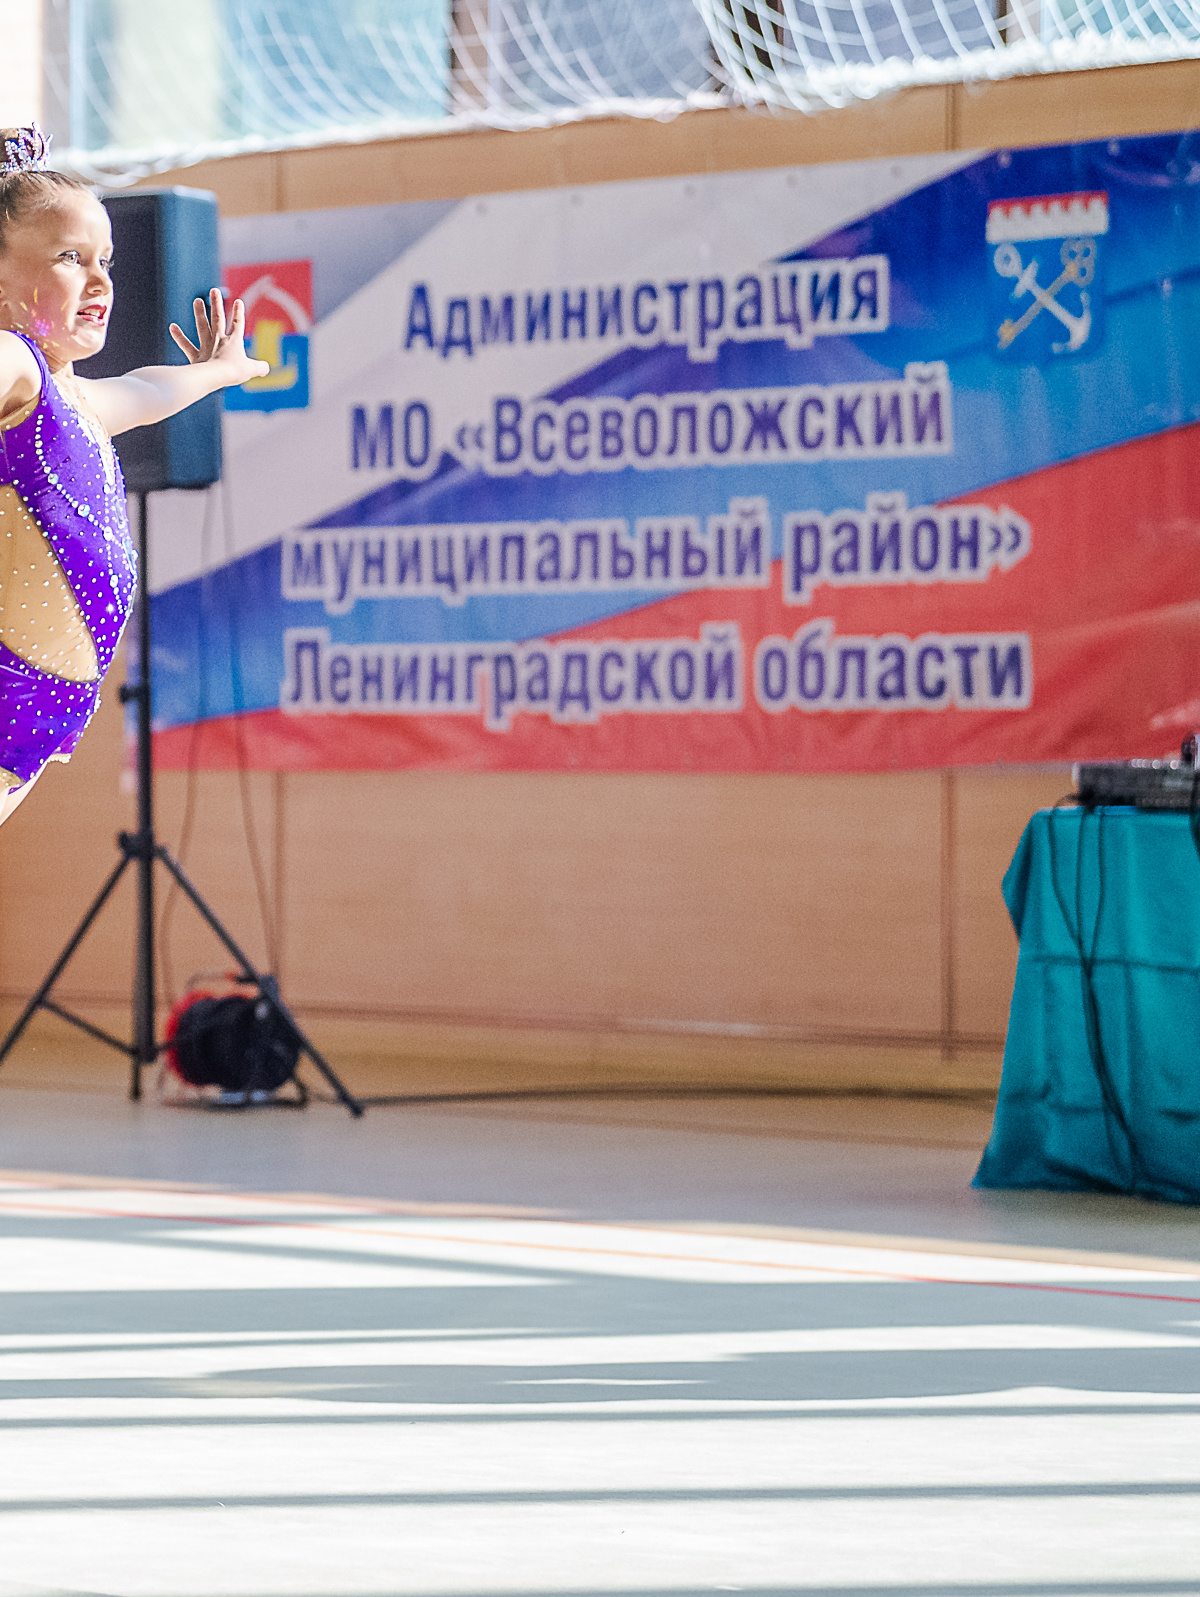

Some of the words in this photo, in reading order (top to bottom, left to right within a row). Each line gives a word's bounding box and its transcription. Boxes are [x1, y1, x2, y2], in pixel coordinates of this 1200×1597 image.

[404, 267, 880, 358] Администрация
[352, 402, 432, 469] МО
[455, 373, 944, 463] «Всеволожский
[291, 509, 763, 602] муниципальный
[790, 502, 1023, 594] район»
[290, 631, 736, 719] Ленинградской
[760, 626, 1023, 703] области
